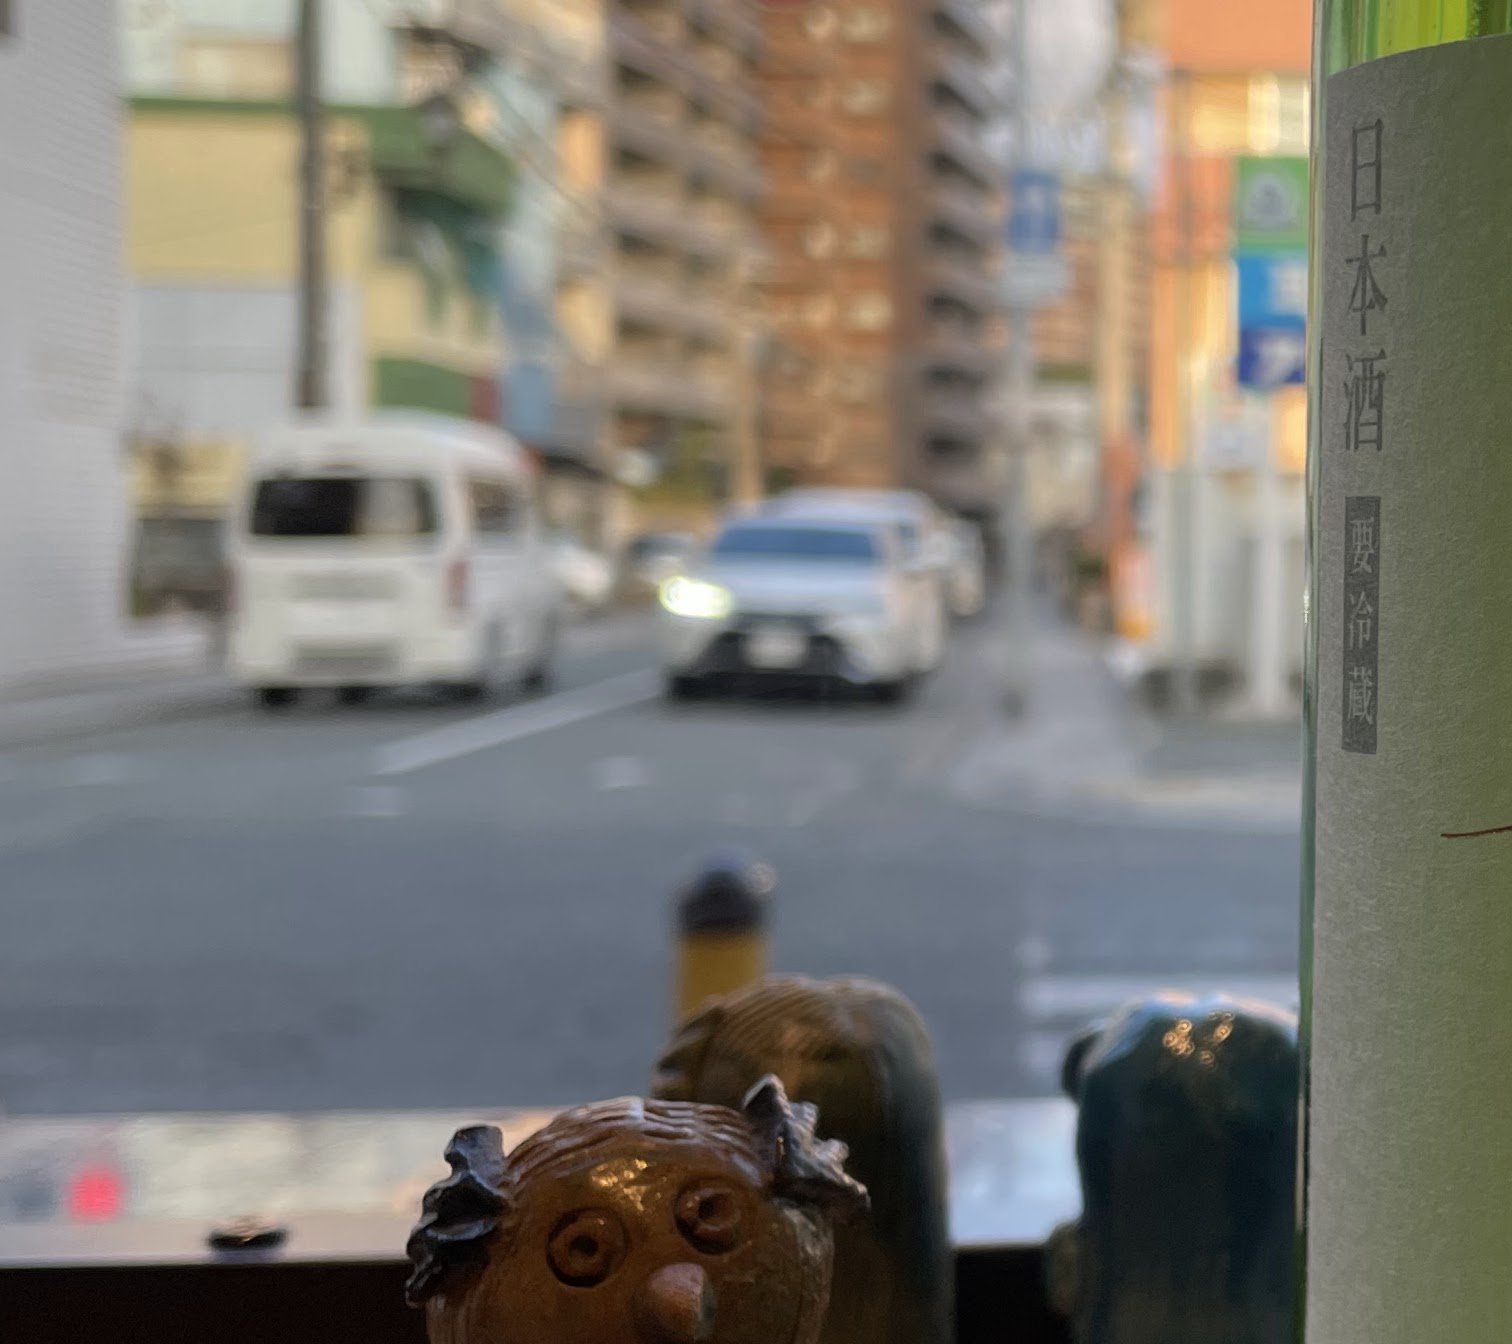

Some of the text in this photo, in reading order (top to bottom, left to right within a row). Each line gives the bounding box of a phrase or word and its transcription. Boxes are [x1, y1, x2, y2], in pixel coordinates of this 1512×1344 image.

[1343, 117, 1388, 452] 日本酒
[1347, 516, 1376, 727] 要冷蔵
